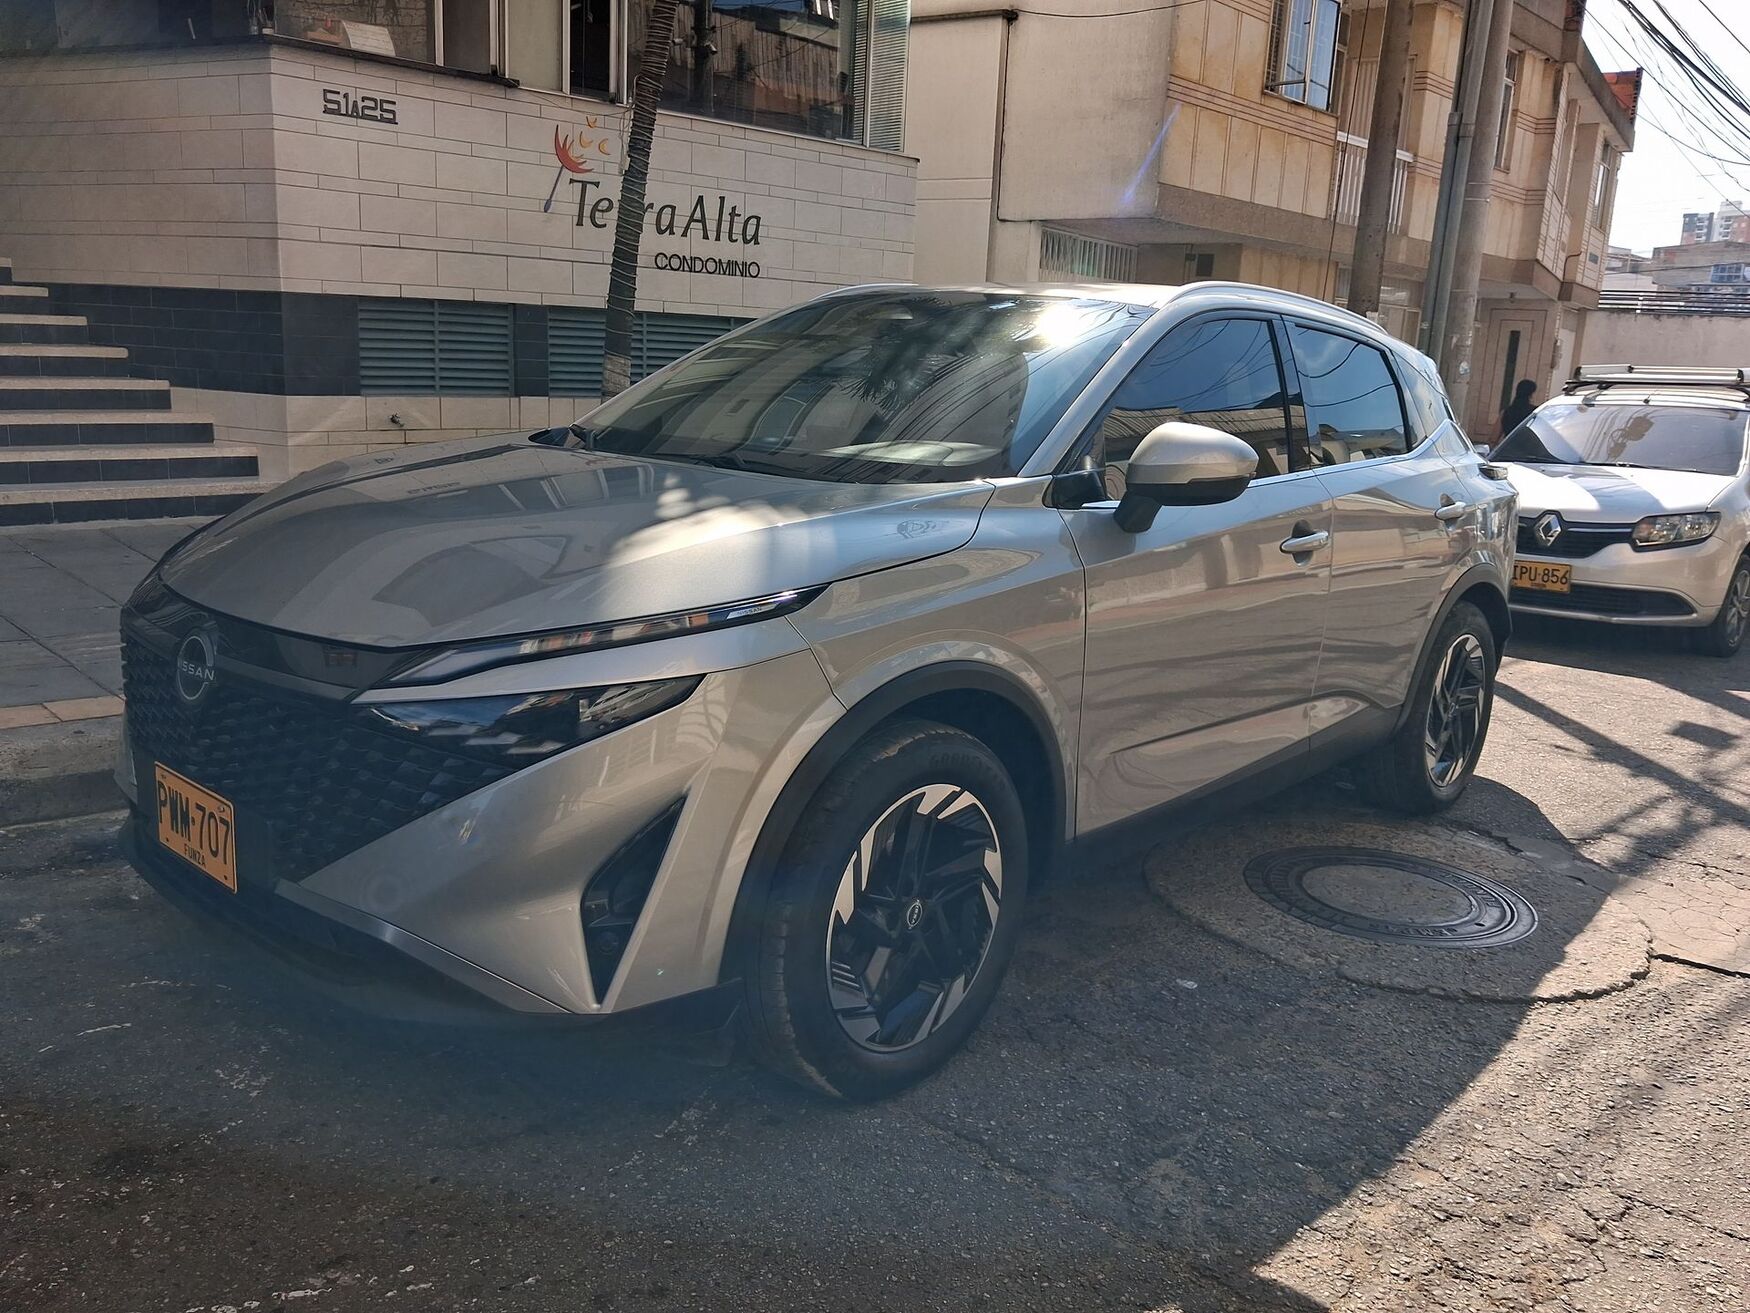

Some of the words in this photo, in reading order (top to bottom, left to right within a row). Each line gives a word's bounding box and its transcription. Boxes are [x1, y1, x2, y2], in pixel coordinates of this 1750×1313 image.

[569, 178, 762, 245] TeaAlta
[654, 252, 761, 279] CONDOMINIO
[183, 843, 207, 869] FUNZA
